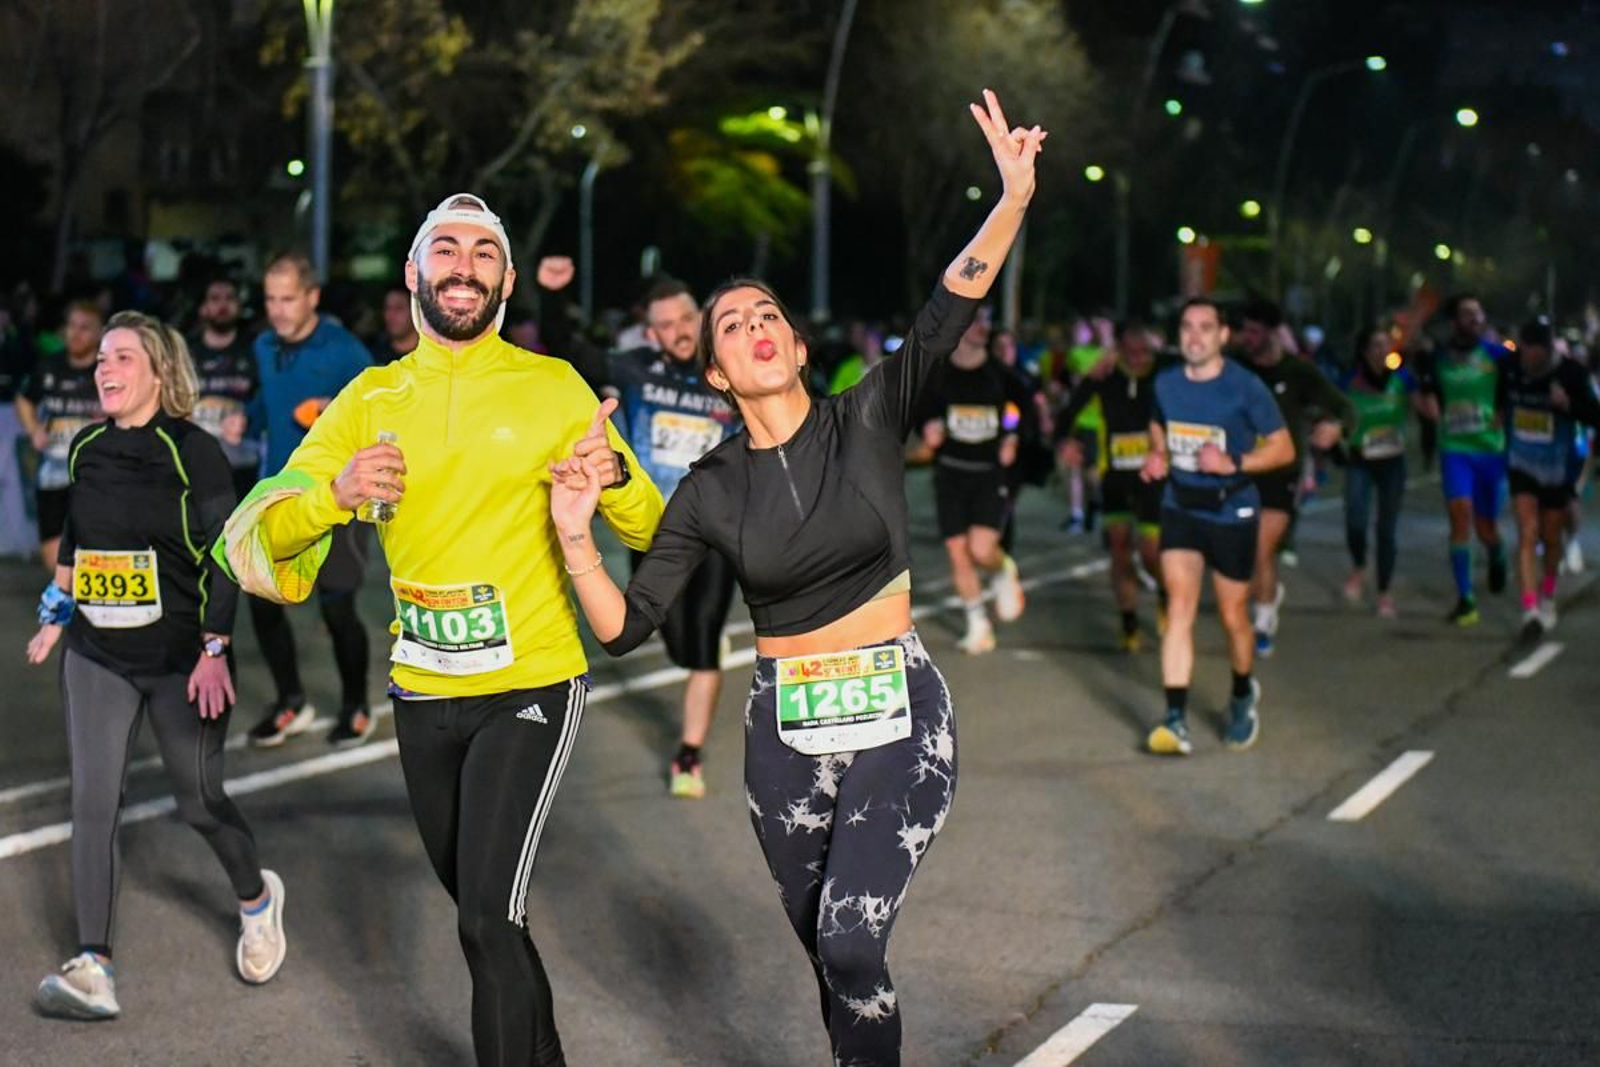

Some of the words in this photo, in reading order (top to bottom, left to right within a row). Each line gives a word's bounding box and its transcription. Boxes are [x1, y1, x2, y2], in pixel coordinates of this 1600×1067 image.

[643, 383, 679, 406] SAN
[80, 572, 149, 598] 3393
[405, 604, 497, 643] 1103
[801, 660, 823, 677] 42
[789, 676, 897, 720] 1265
[516, 712, 548, 724] adidas
